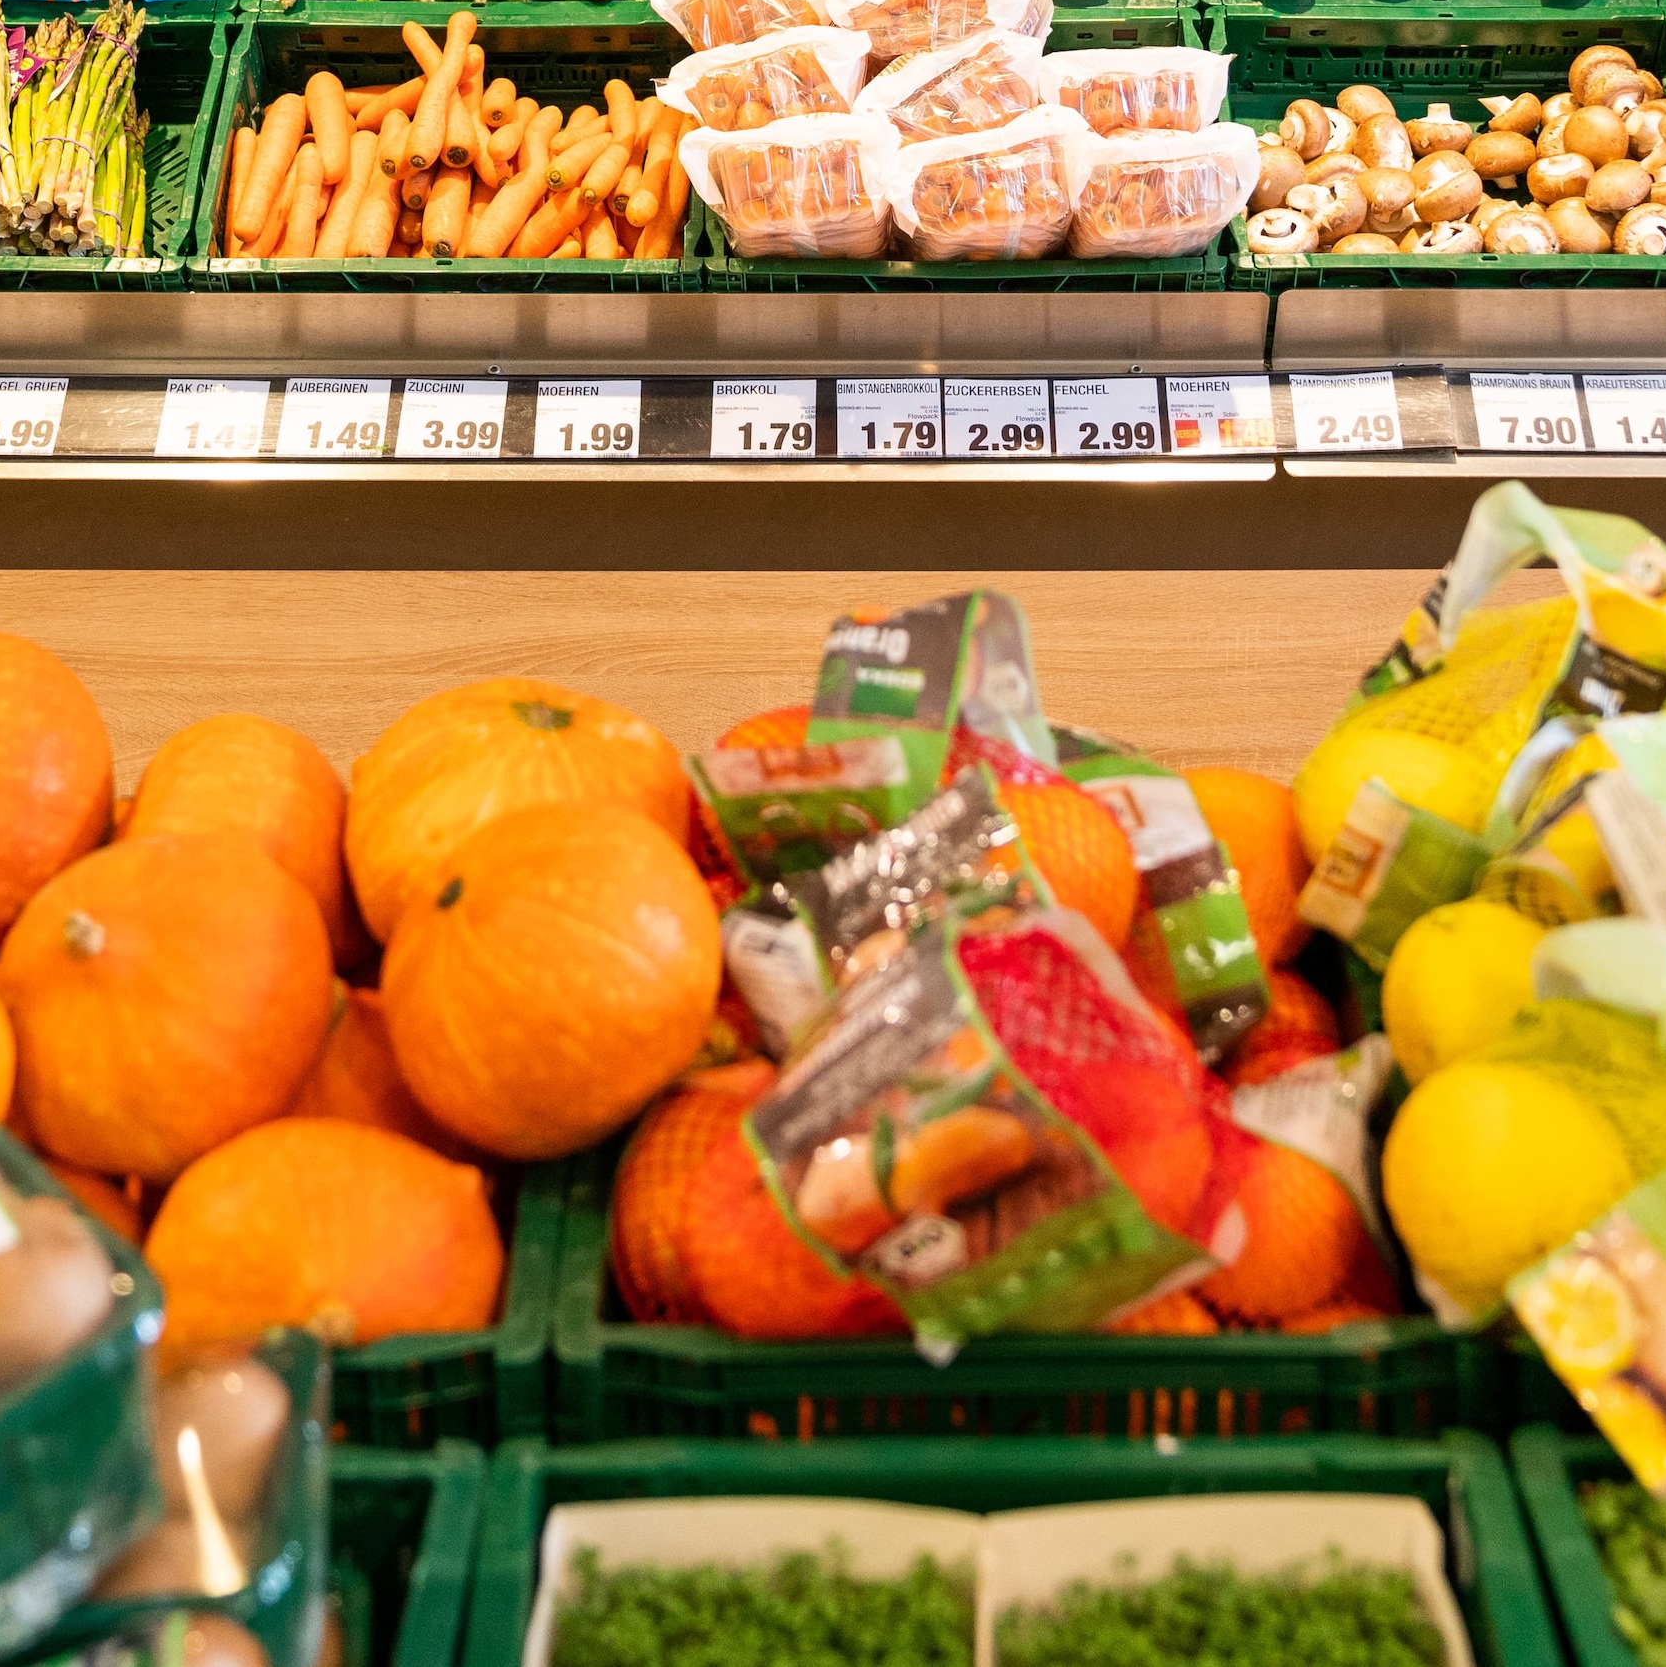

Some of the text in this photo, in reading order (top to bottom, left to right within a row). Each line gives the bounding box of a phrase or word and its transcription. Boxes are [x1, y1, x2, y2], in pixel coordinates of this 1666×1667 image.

[25, 380, 66, 392] GRUEN
[170, 383, 192, 394] PAK
[290, 382, 368, 394] AUBERGINEN
[408, 382, 465, 394] ZUCCHINI
[838, 382, 938, 394] BIMI STANGENBROKKOLI
[1169, 381, 1230, 392] MOEHREN
[1290, 376, 1389, 389] CHAMPIGNONS BRAUN
[1471, 378, 1571, 390] CHAMPIGNONS BRAUN
[539, 386, 599, 396] MOEHREN
[717, 384, 777, 395] BROKKOLI
[945, 386, 1041, 396] ZUCKERERBSEN
[1055, 384, 1109, 395] FENCHEL
[185, 421, 259, 449] 1.49
[307, 421, 381, 449] 1.49
[422, 420, 499, 450] 3.99
[861, 422, 936, 450] 1.79
[1079, 422, 1155, 450] 2.99
[1219, 419, 1274, 447] 1.49
[1317, 415, 1394, 444] 2.49
[1499, 416, 1577, 444] 7.90
[559, 422, 633, 451] 1.99
[738, 422, 813, 451] 1.79
[969, 424, 1044, 451] 2.99
